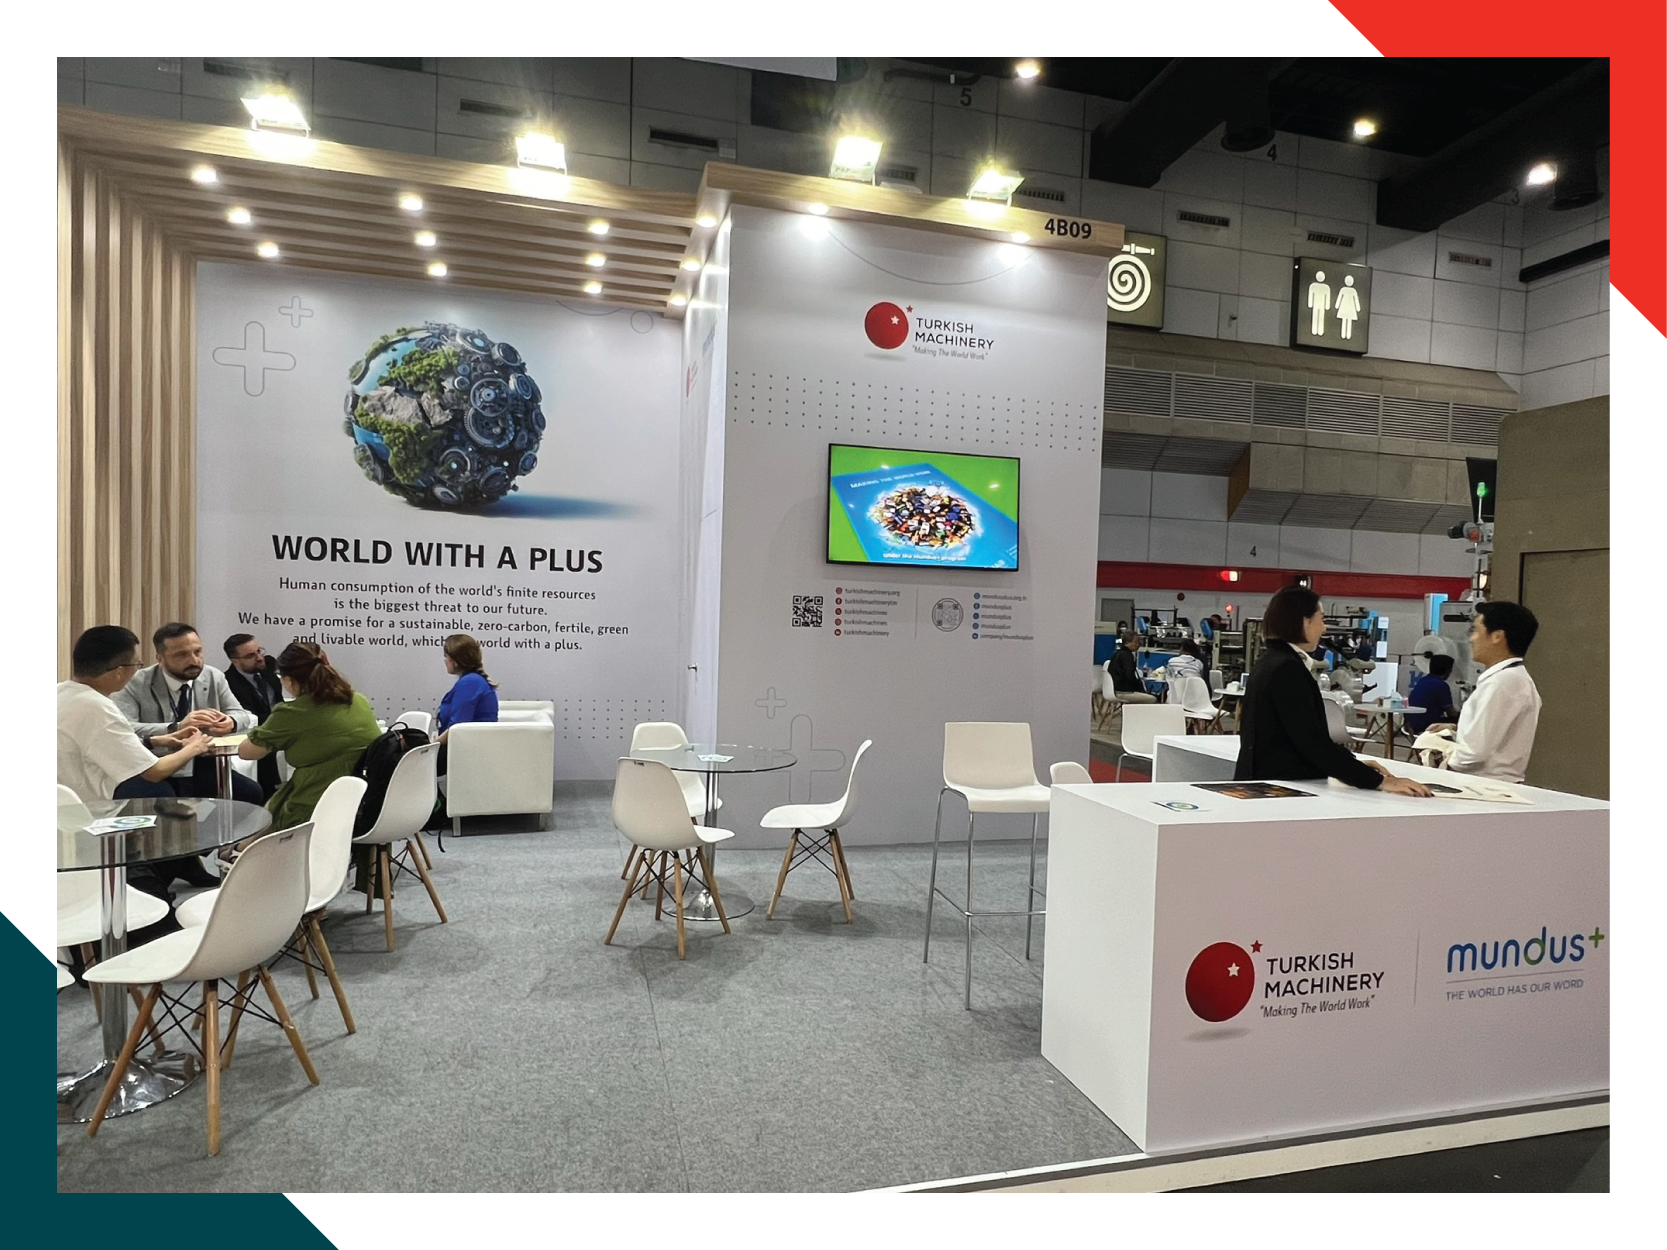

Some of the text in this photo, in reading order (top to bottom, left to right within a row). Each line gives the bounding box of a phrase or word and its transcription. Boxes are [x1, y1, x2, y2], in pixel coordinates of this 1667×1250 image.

[960, 87, 972, 106] 5
[1267, 144, 1277, 161] 4
[1044, 218, 1092, 239] 4B09
[916, 317, 974, 334] TURKISH
[915, 331, 994, 350] MACHINERY
[938, 348, 949, 357] The
[951, 350, 968, 359] World
[272, 534, 603, 573] WORLD WITH A PLUS
[1249, 545, 1257, 558] 4
[279, 577, 596, 600] Human consumption of the world's finite resources
[845, 588, 900, 597] turkishmachinery.org
[334, 598, 547, 616] is the biggest threat to our future.
[238, 612, 629, 636] We have a promise for a sustainable, zero-carbon, fertile, green
[293, 632, 583, 653] and livable world, which world with a plus.
[1266, 951, 1354, 976] TURKISH
[1264, 971, 1385, 999] MACHINERY
[1446, 979, 1584, 1001] THE WORLD HAS OUR WORD
[1300, 1001, 1317, 1015] The
[1318, 999, 1346, 1013] World
